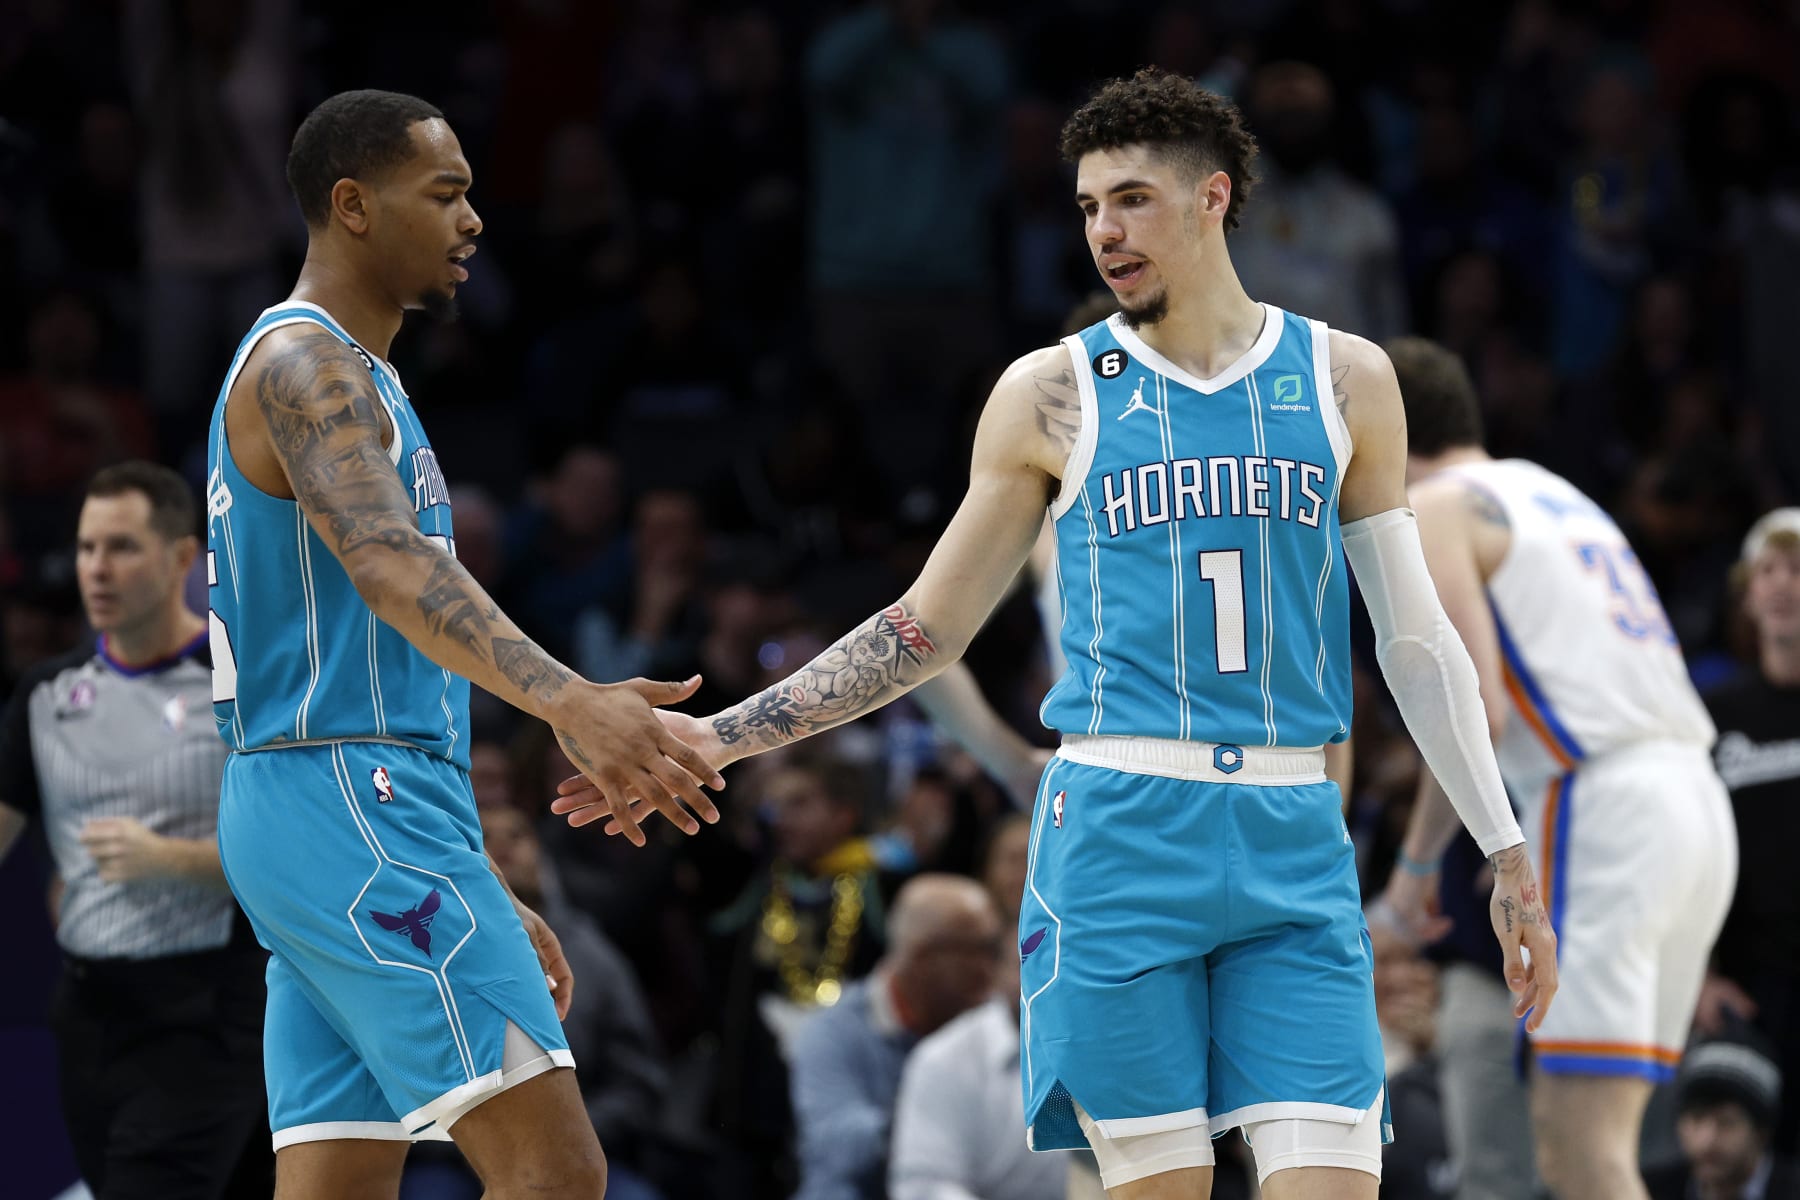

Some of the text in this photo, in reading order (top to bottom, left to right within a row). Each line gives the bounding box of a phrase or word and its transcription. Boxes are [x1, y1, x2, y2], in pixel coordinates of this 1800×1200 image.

[1101, 352, 1121, 376] 6
[1270, 403, 1311, 412] lendingtree
[1100, 455, 1327, 538] HORNETS
[1197, 549, 1249, 674] 1
